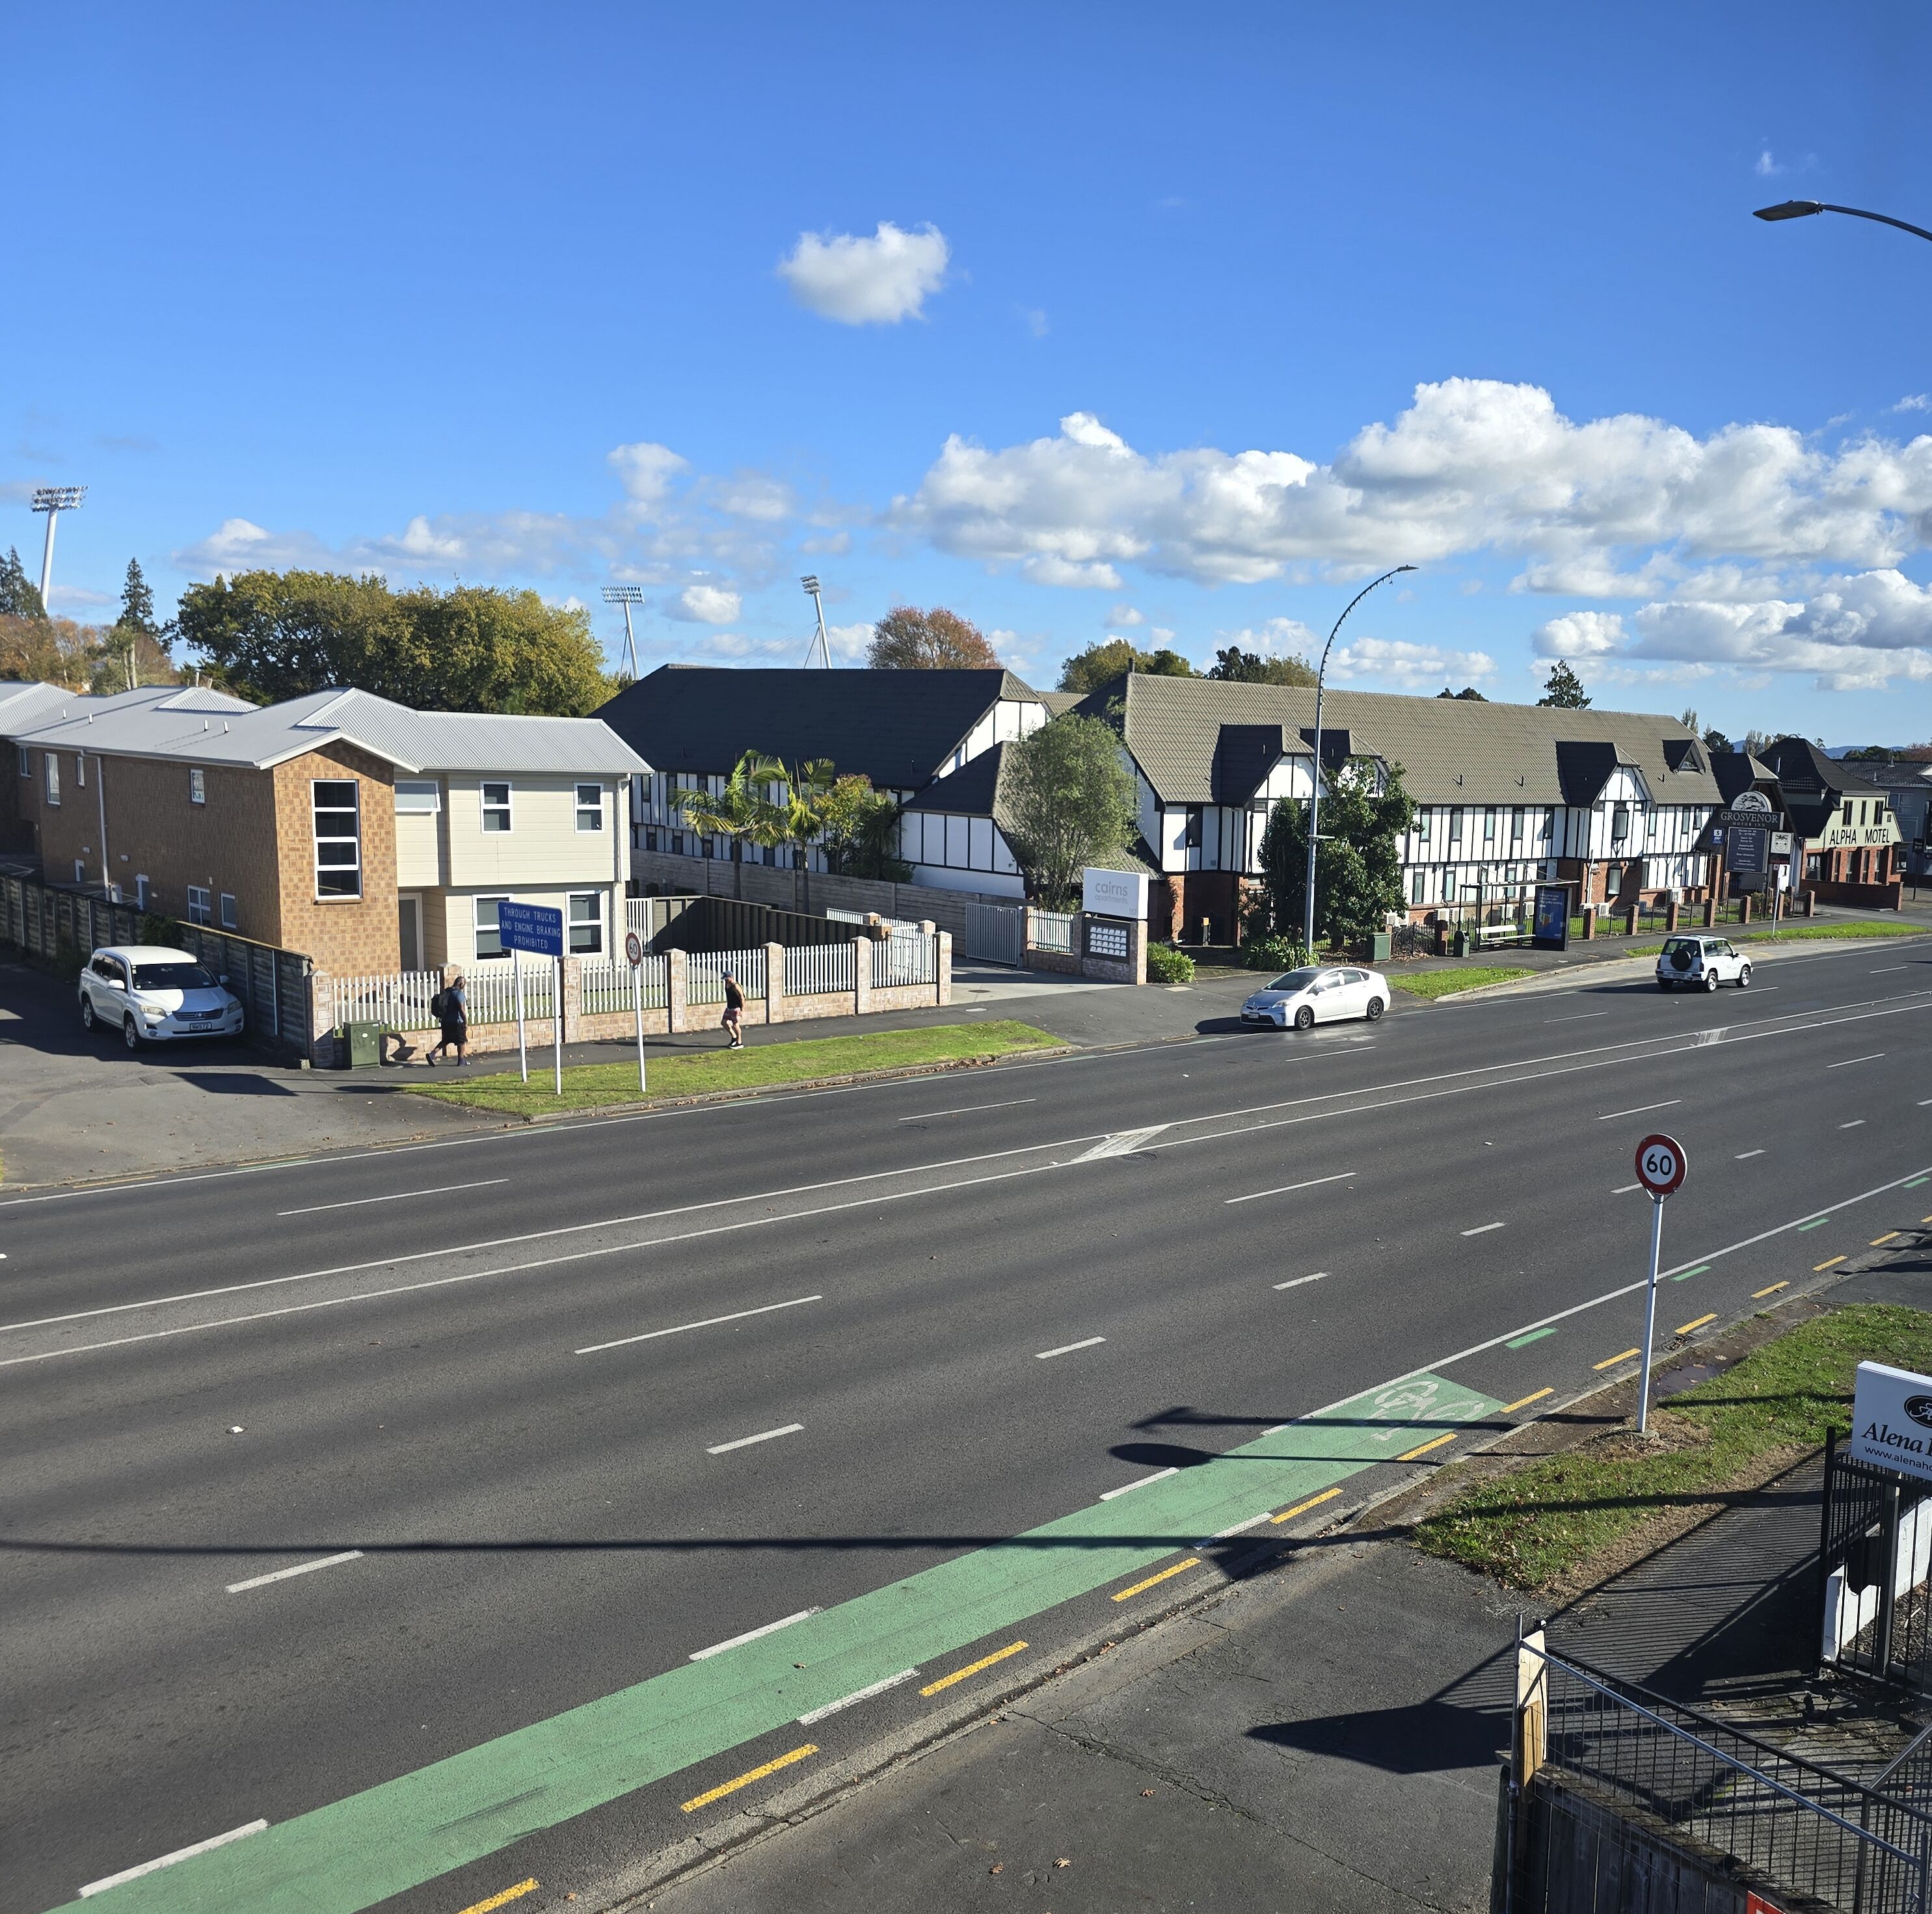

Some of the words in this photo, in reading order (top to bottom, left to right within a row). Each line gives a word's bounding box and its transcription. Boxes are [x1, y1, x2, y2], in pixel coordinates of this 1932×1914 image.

[1721, 812, 1778, 823] GROSVENOR
[1829, 829, 1857, 845] ALPHA
[1864, 828, 1890, 844] MOTEL
[1095, 881, 1128, 896] cairns
[1094, 894, 1128, 904] apartments
[503, 907, 530, 920] THROUGH
[533, 910, 556, 924] TRUCKS
[501, 920, 512, 931] AND
[515, 922, 533, 934] ENGINE
[536, 925, 561, 938] BRAKING
[514, 935, 548, 949] PROHIBITED
[629, 942, 637, 955] 60
[1646, 1153, 1672, 1176] 60
[1860, 1422, 1923, 1454] Alena
